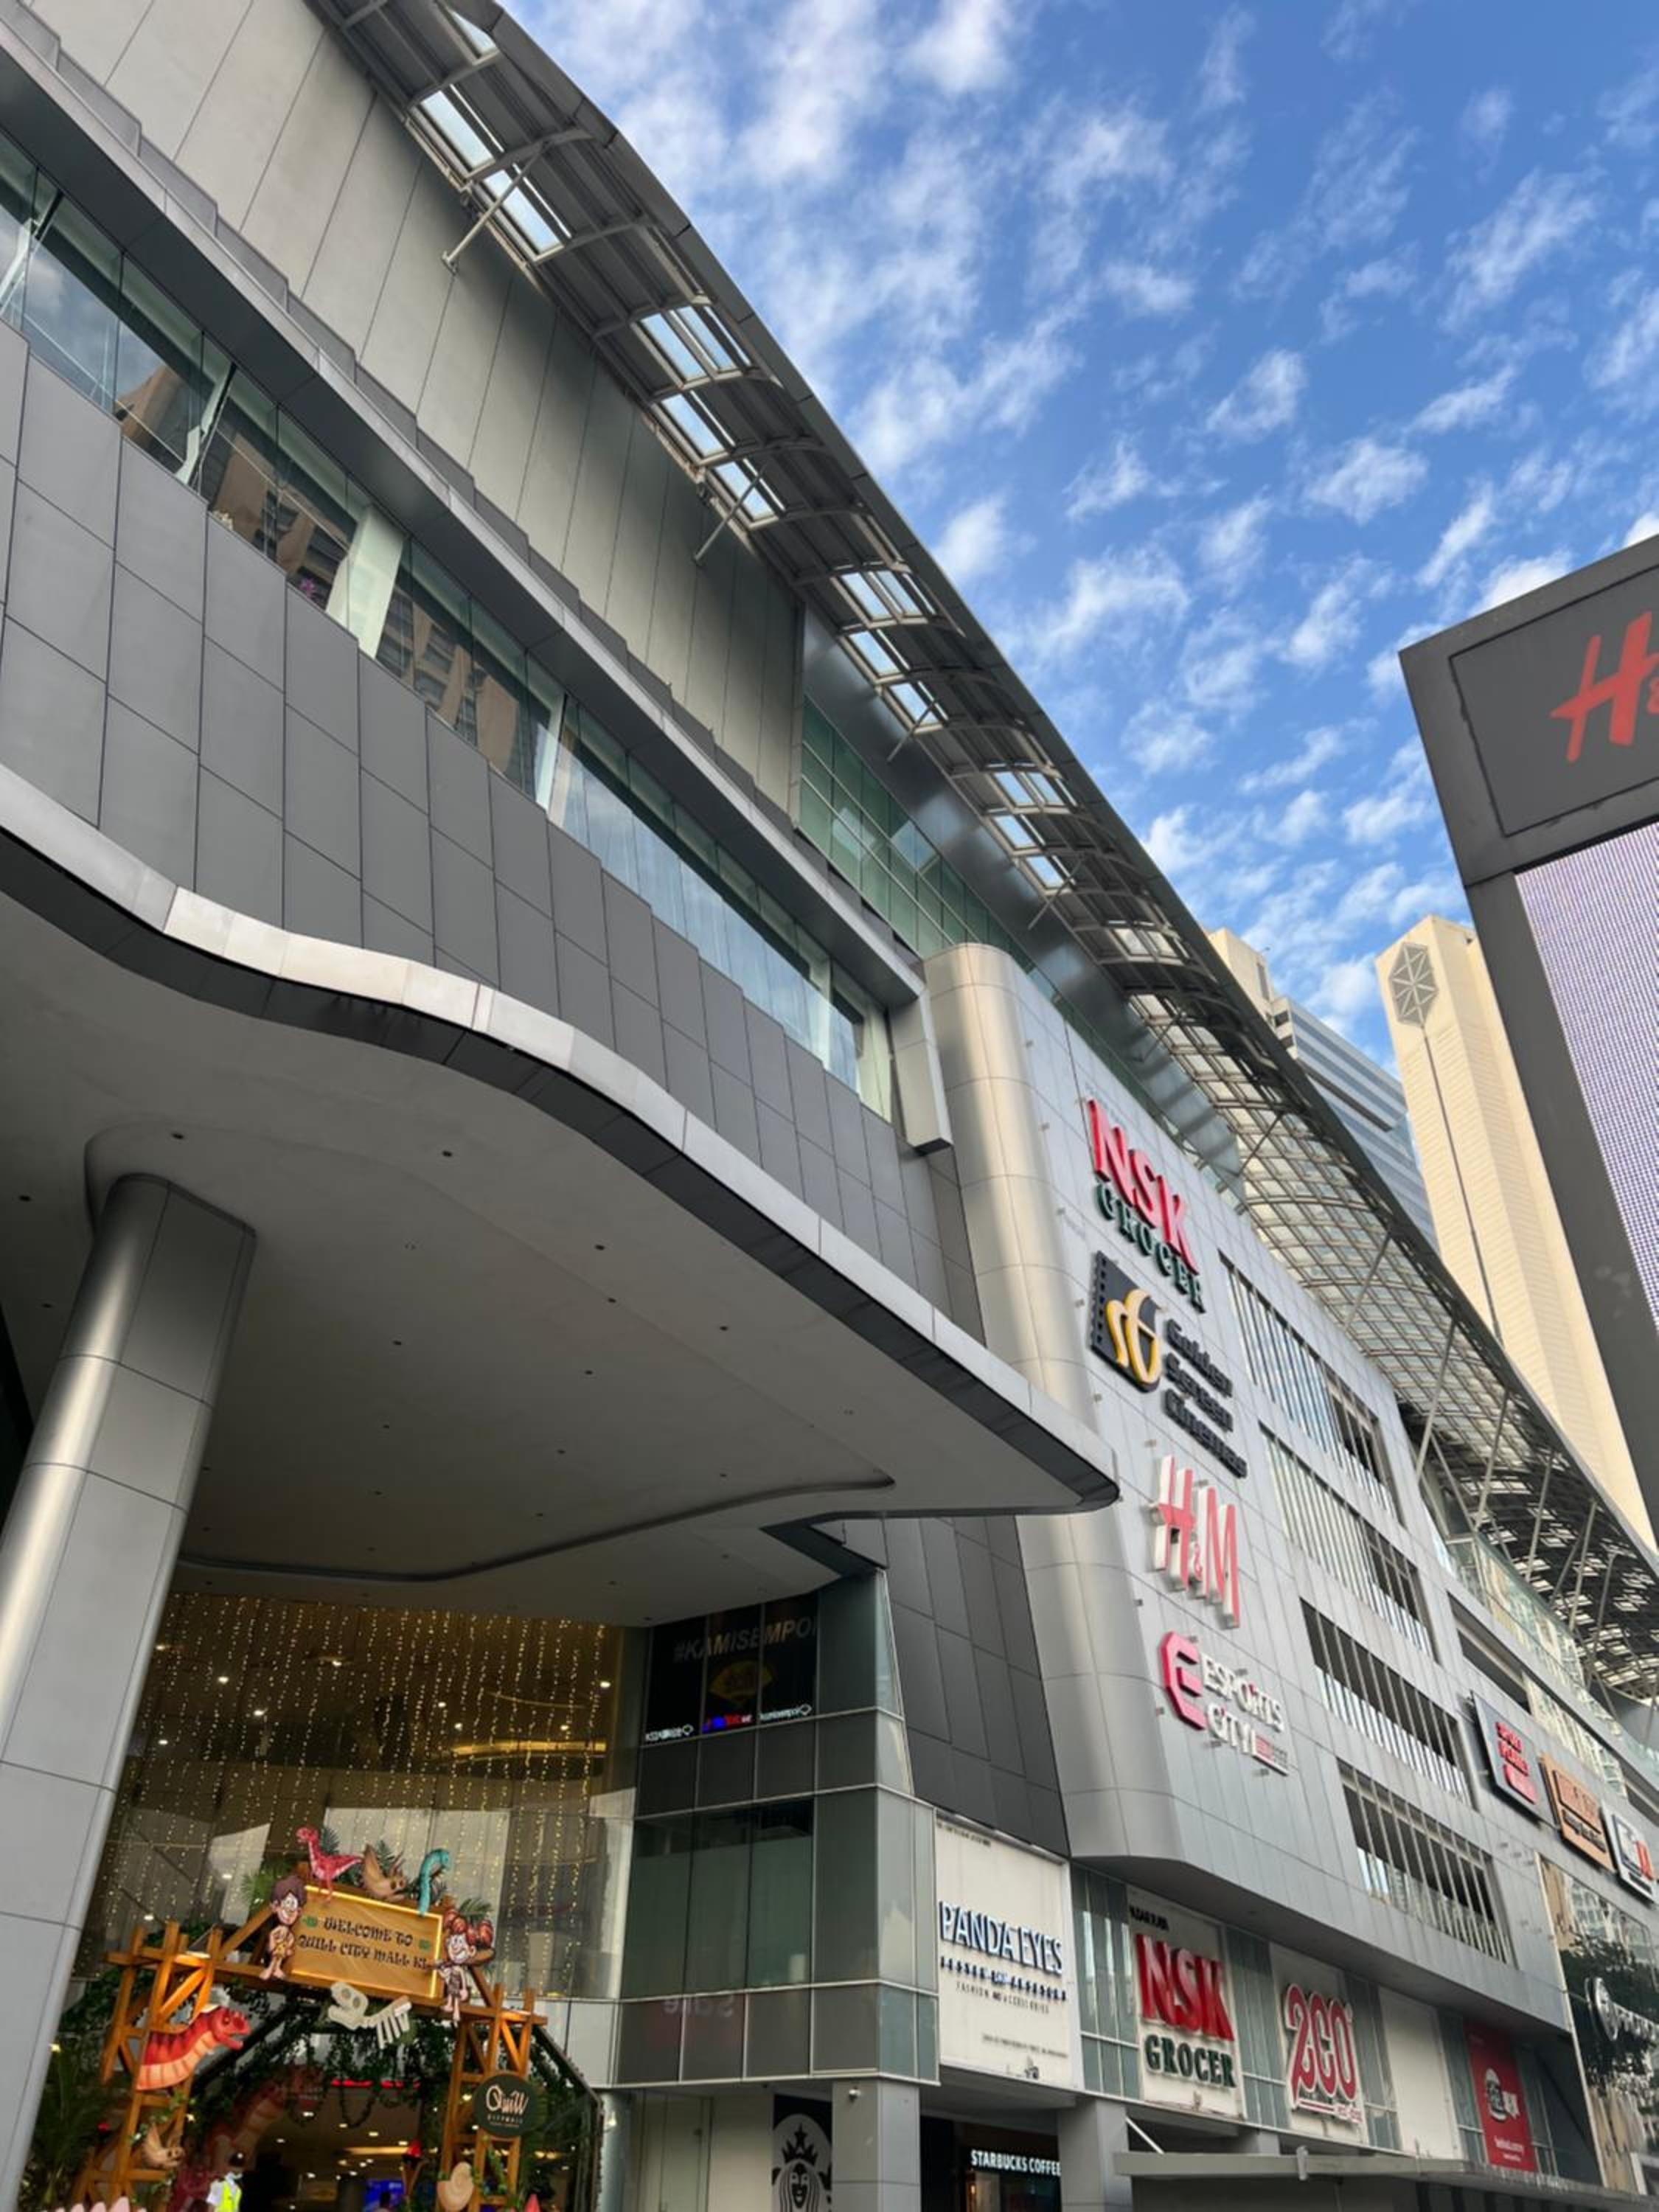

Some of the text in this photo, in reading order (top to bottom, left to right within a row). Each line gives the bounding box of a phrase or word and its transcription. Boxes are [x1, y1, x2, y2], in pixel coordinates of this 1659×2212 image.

[1088, 1099, 1199, 1276] NSK
[1094, 1180, 1206, 1313] GROCER
[1151, 1455, 1240, 1629] H&M
[1200, 1652, 1284, 1733] ESPORTS
[298, 1934, 337, 1953] QUILL
[340, 1942, 369, 1959] CITY
[374, 1948, 410, 1964] MALL
[324, 1917, 414, 1947] WELCOME TO
[939, 1900, 1016, 1963] PANDA
[1017, 1925, 1063, 1979] EYES
[1135, 1933, 1235, 2042] NSK
[486, 2084, 529, 2114] Quill
[1145, 2034, 1237, 2089] GROCER
[971, 2149, 1062, 2177] STARBUCKS COFFEE
